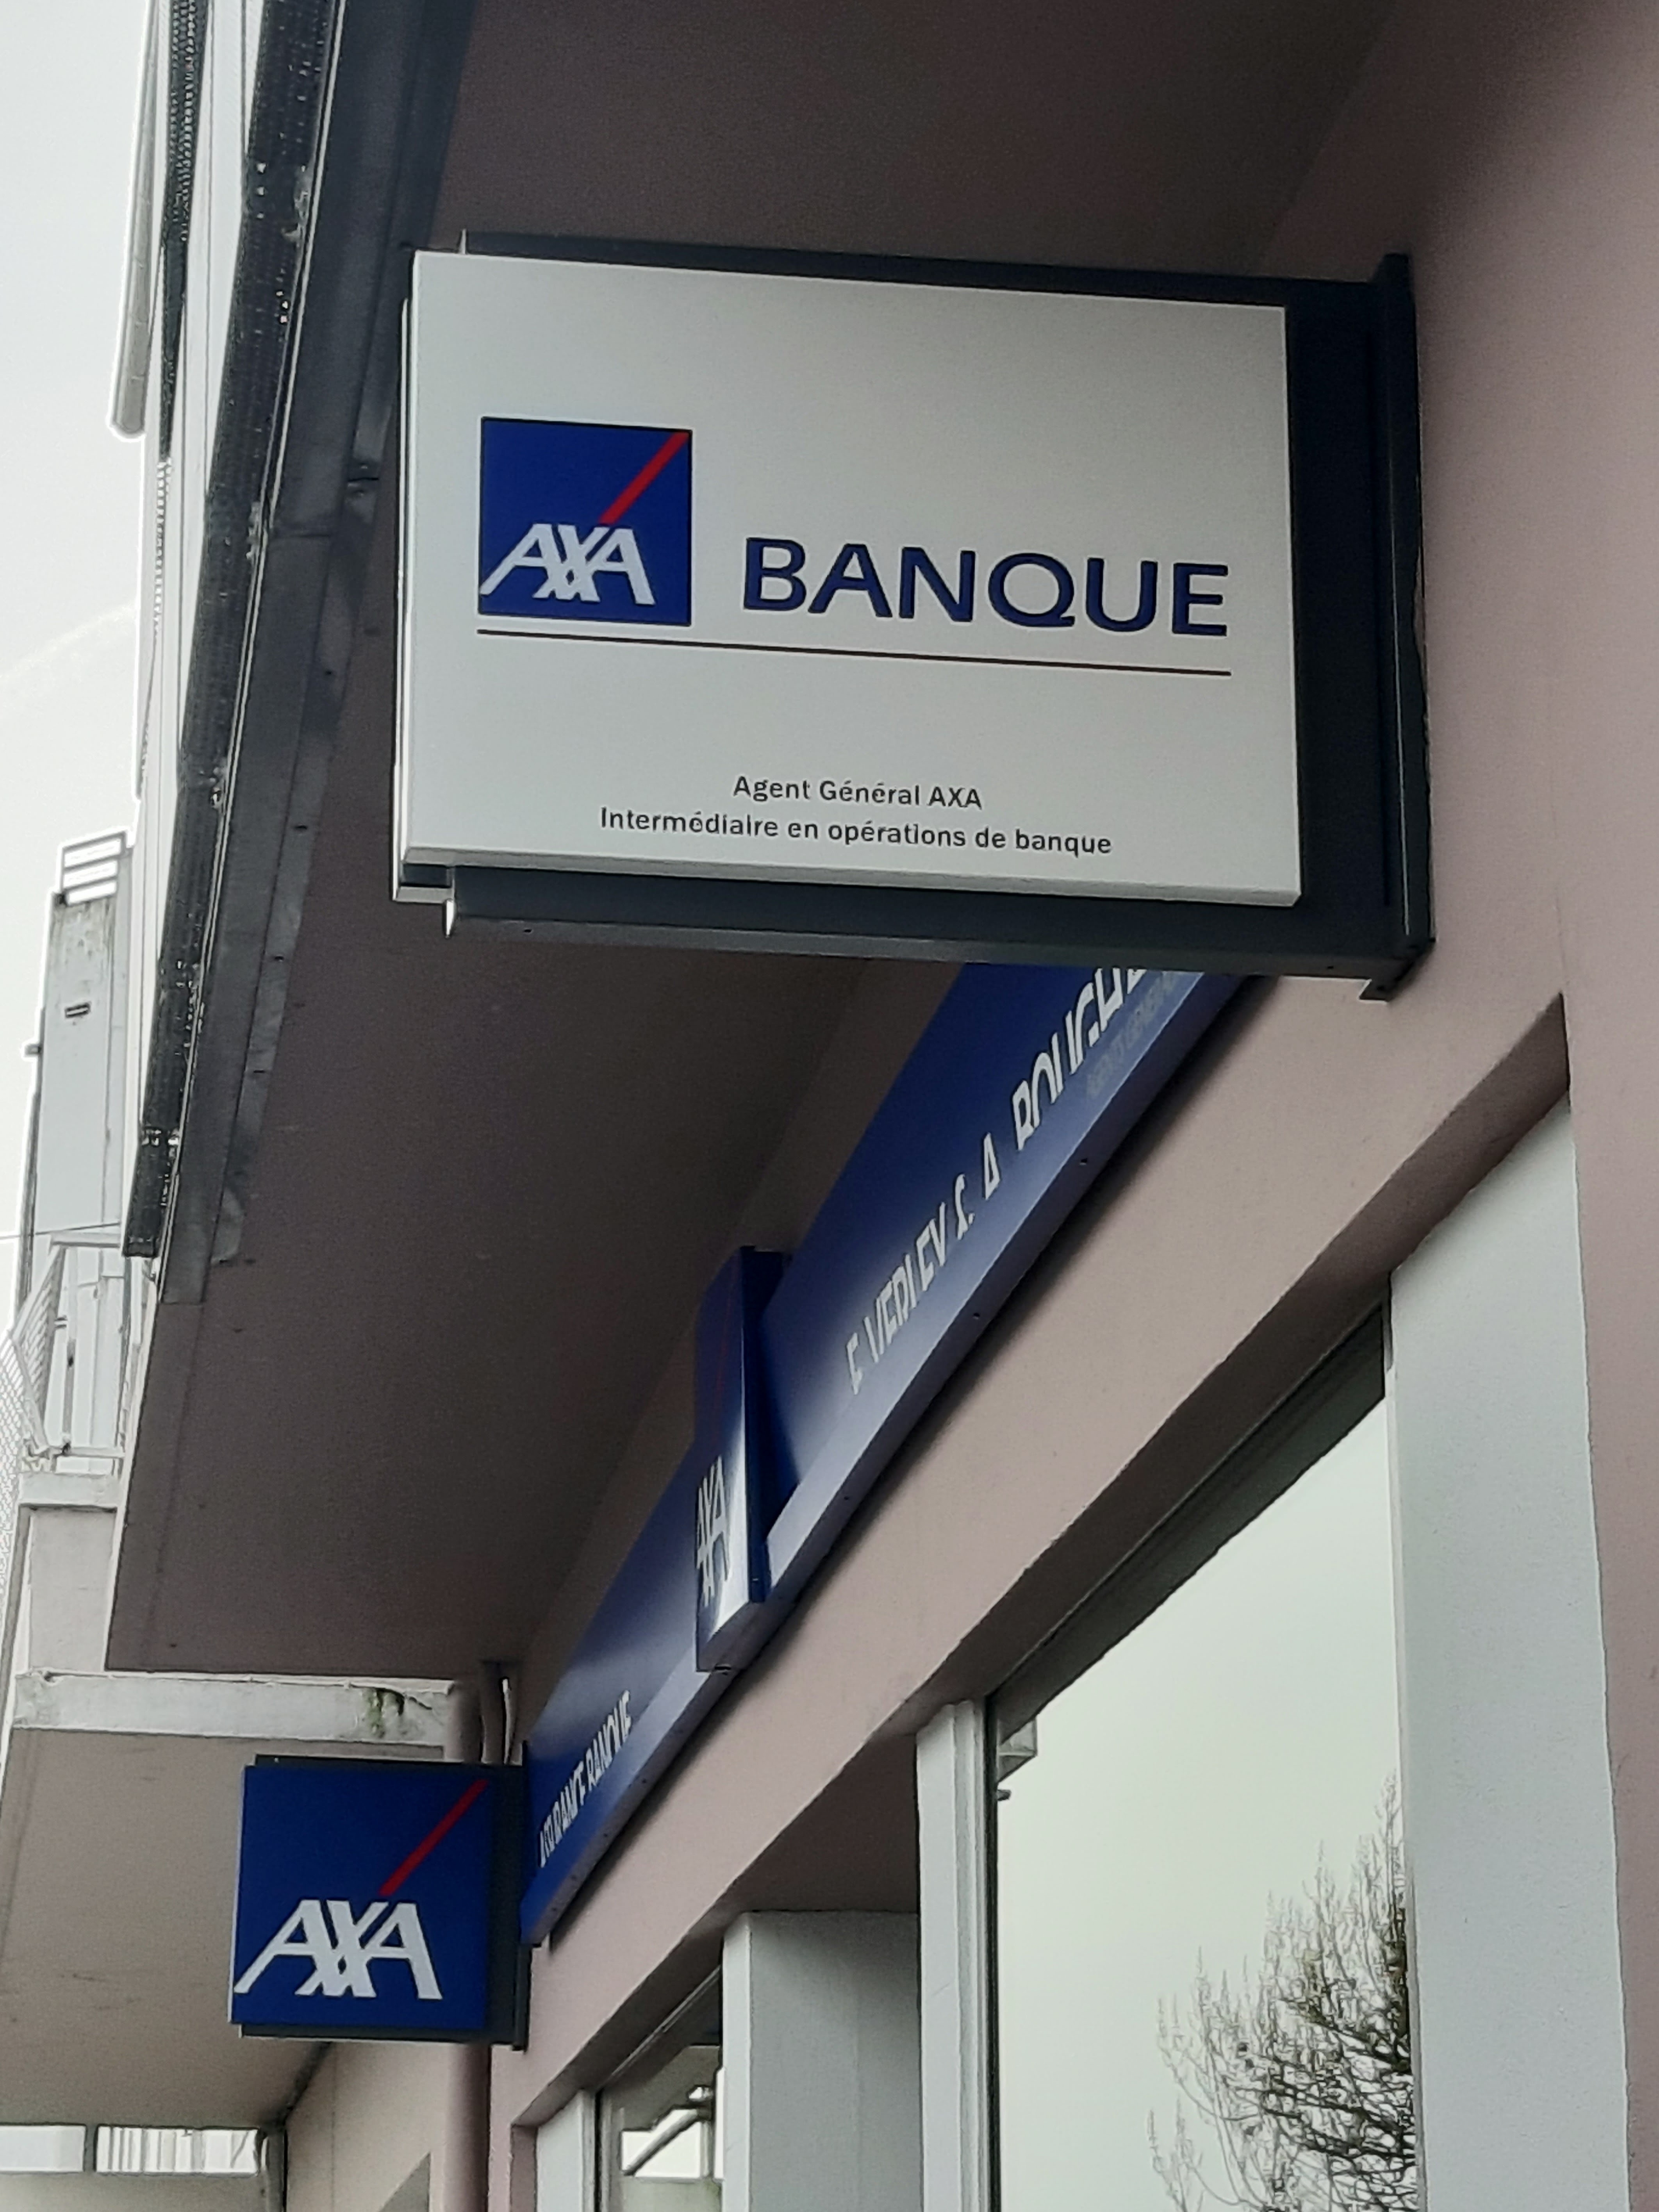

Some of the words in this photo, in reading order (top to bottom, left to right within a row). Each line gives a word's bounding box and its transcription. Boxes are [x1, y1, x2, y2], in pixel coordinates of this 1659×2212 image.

[480, 524, 655, 605] AXA
[743, 537, 1229, 637] BANQUE
[733, 776, 810, 802] Agent
[820, 780, 920, 806] Général
[928, 786, 982, 810] AXA
[601, 807, 778, 837] Intermédiaire
[788, 822, 818, 839] en
[828, 821, 966, 847] opérations
[975, 826, 1006, 849] de
[1016, 829, 1111, 858] banque
[233, 1899, 443, 2000] AXA
